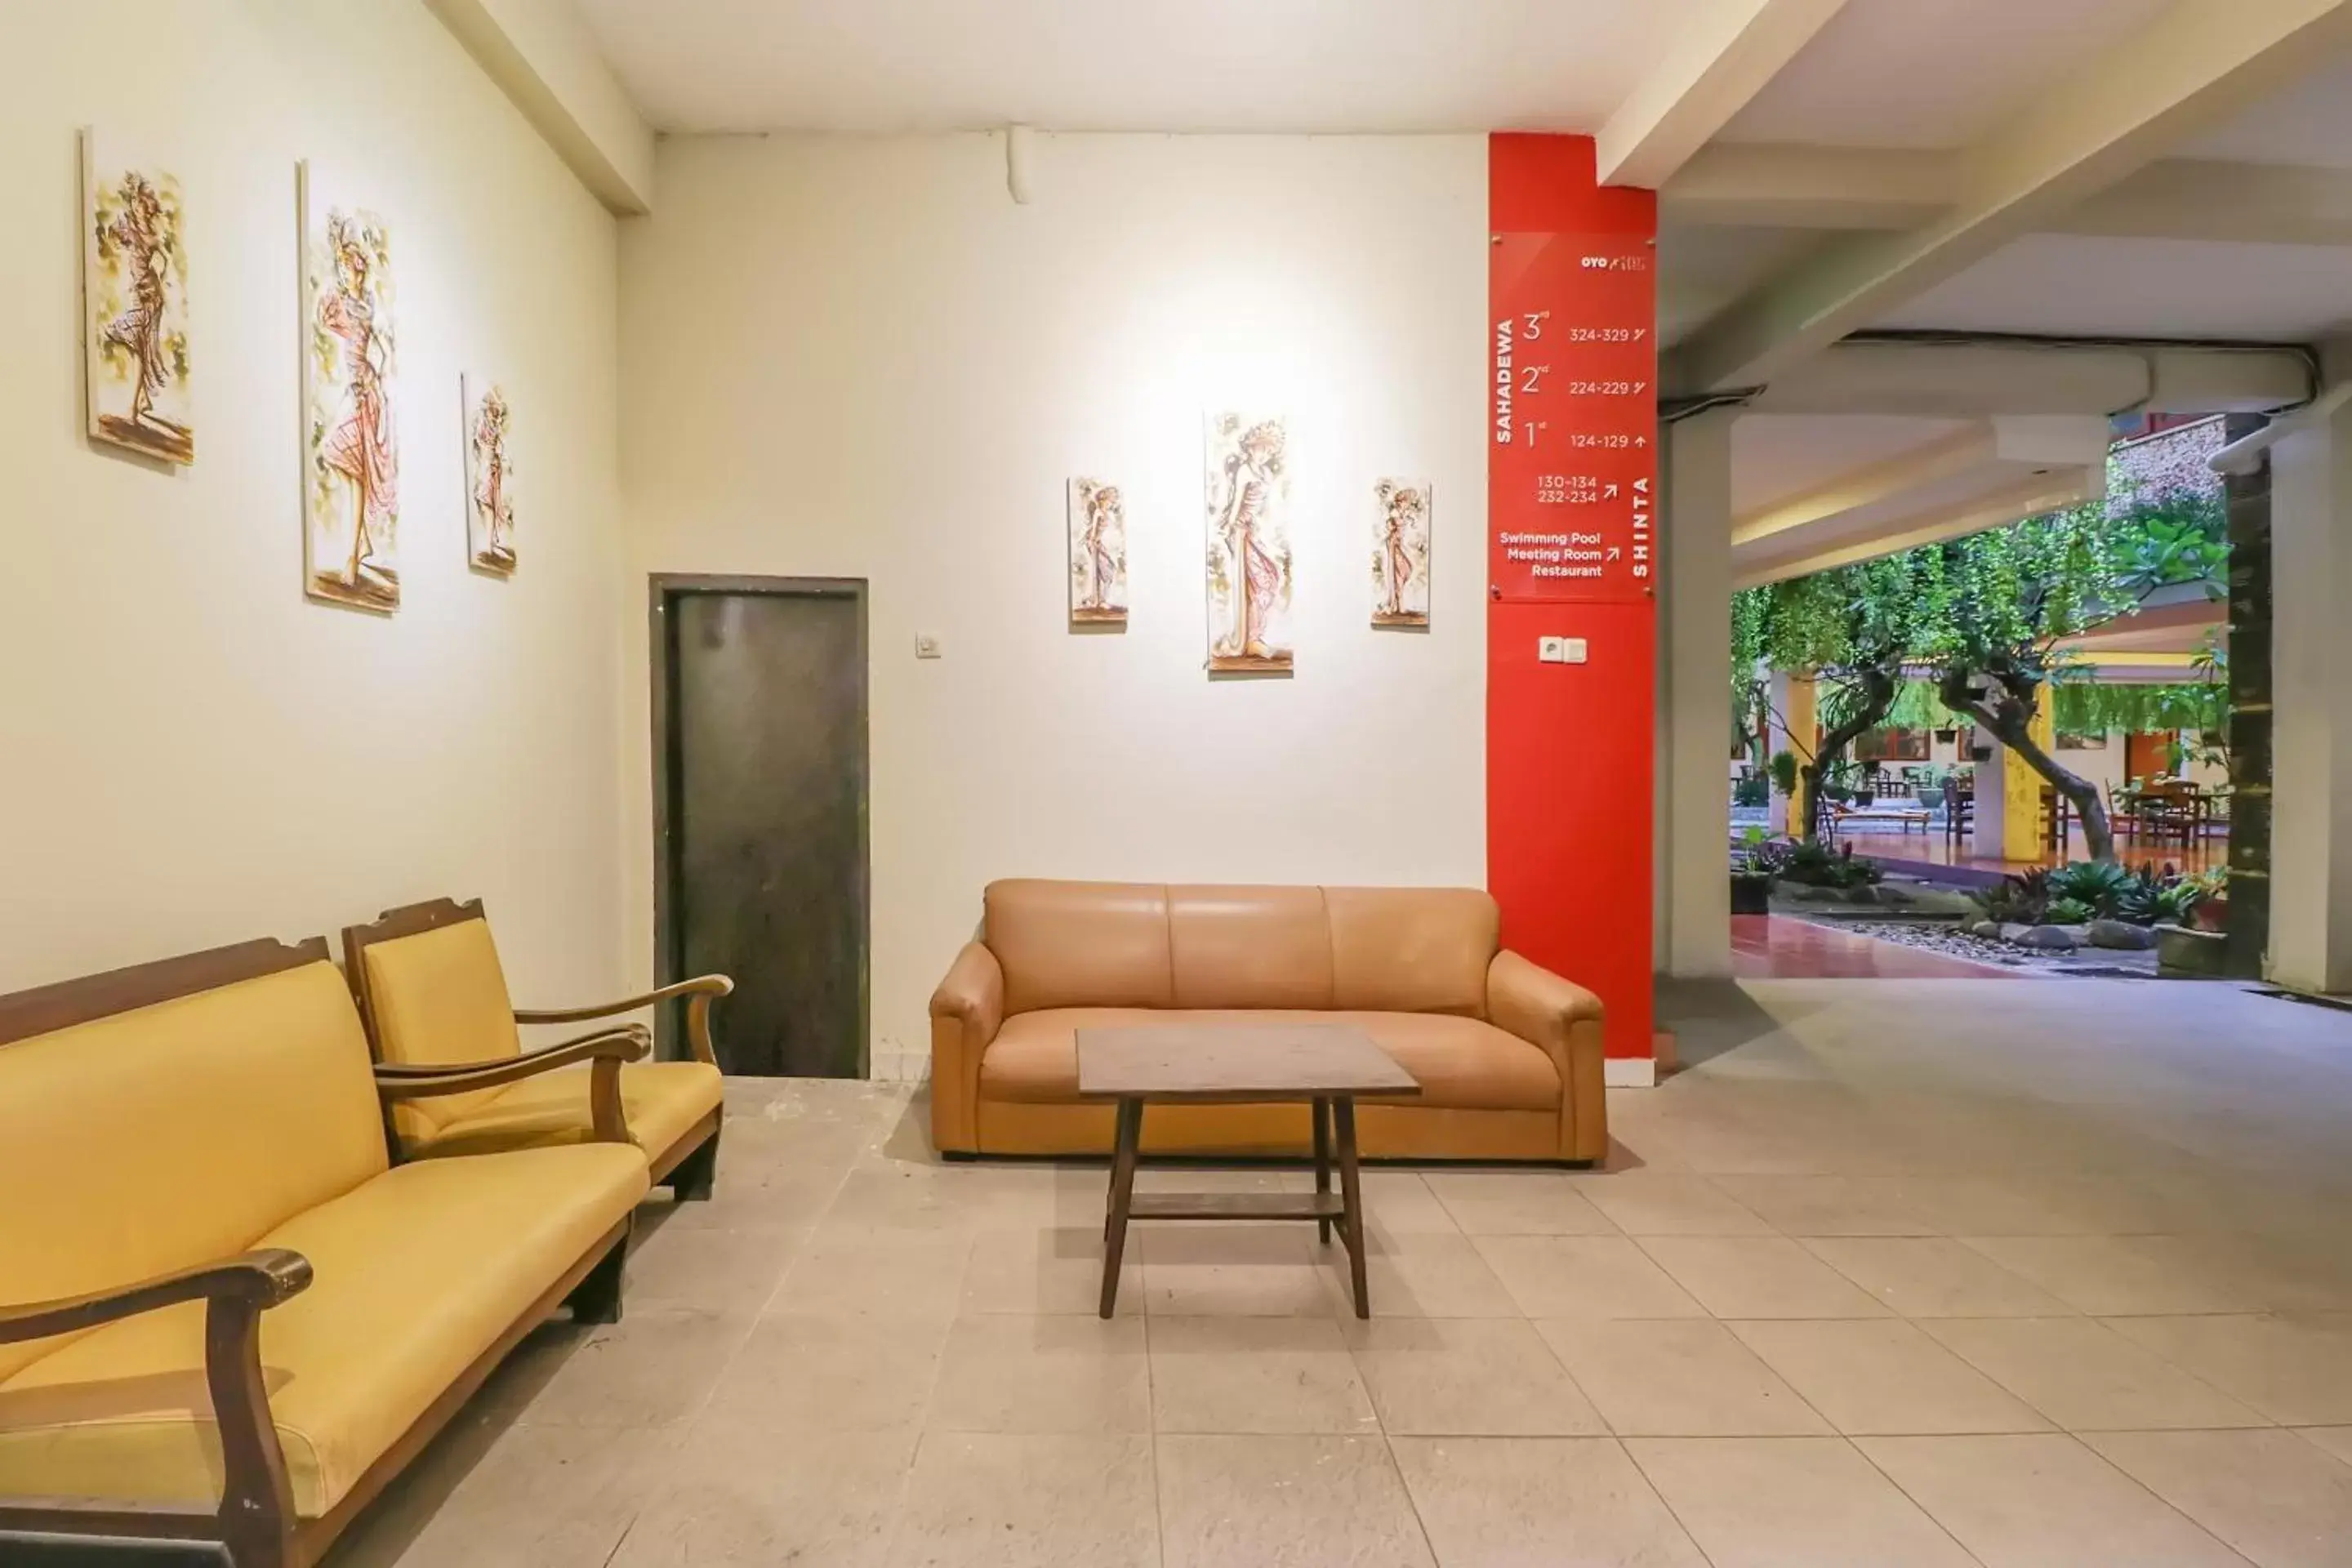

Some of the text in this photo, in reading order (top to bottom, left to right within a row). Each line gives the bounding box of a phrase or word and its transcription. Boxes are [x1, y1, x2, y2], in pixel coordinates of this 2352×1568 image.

[1581, 256, 1607, 267] OYO
[1570, 328, 1629, 341] 324-329
[1497, 319, 1512, 443] SAHADEWA
[1570, 381, 1629, 394] 224-229
[1570, 435, 1629, 448] 124-129
[1538, 476, 1597, 488] 130-134
[1539, 491, 1597, 503] 232-234
[1633, 478, 1648, 577] SHINTA
[1500, 532, 1601, 546] Swimming Pool
[1508, 548, 1602, 562] Meeting Room
[1532, 564, 1602, 577] Restaurant
